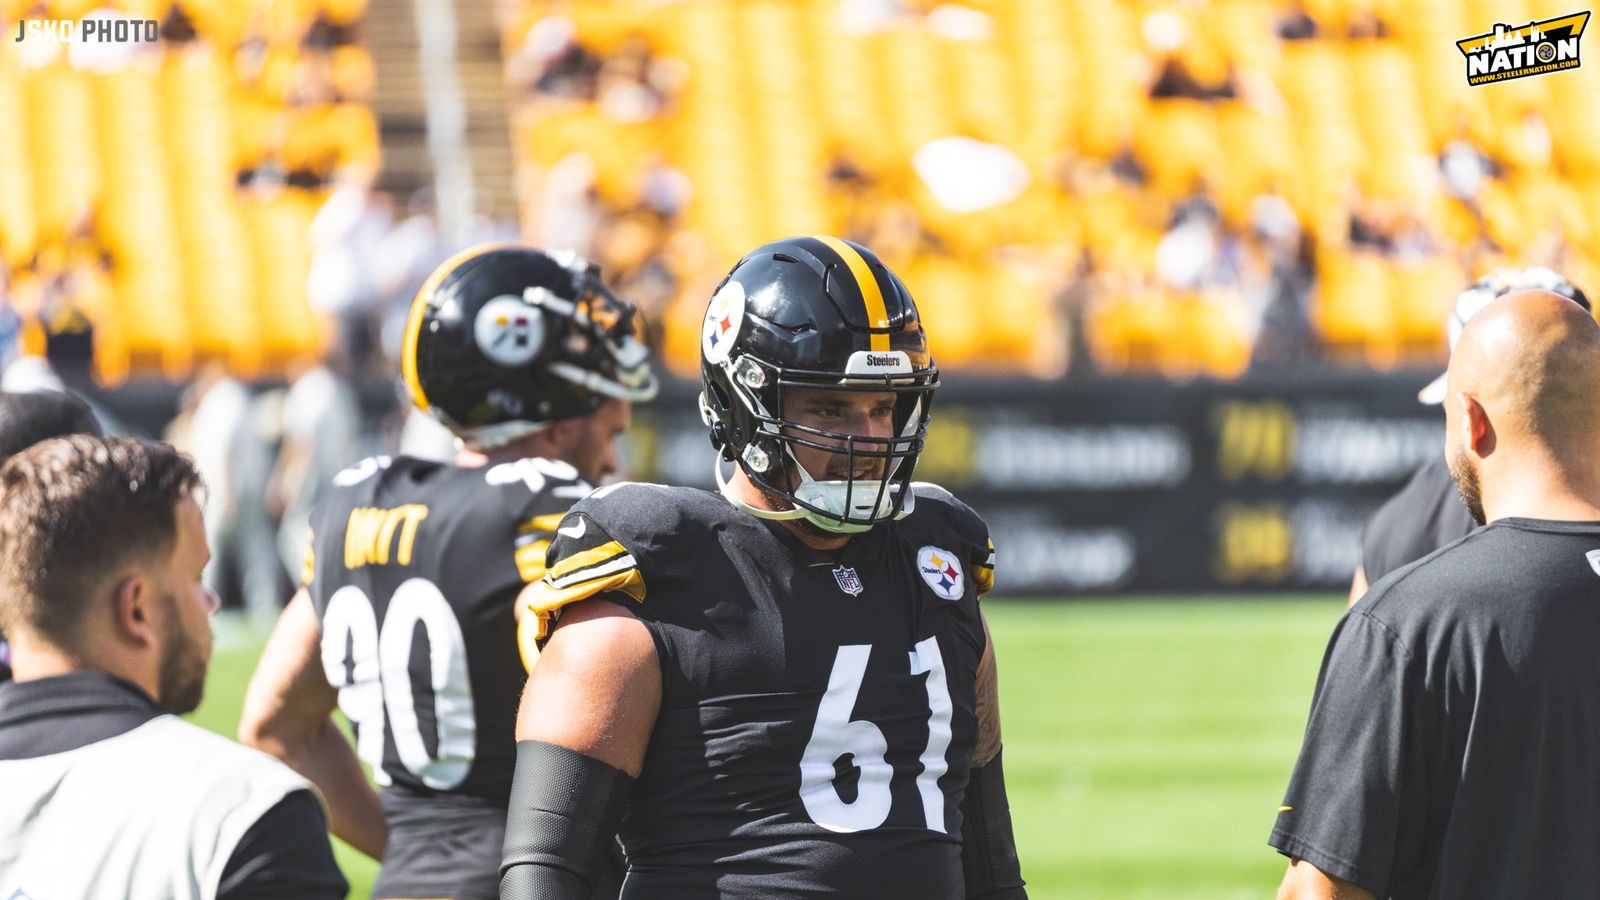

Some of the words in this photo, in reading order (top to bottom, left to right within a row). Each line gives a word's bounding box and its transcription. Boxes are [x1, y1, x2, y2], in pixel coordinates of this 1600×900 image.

[866, 354, 900, 366] Steelers
[841, 578, 860, 590] NFL
[321, 577, 476, 790] 90
[799, 635, 953, 834] 61
